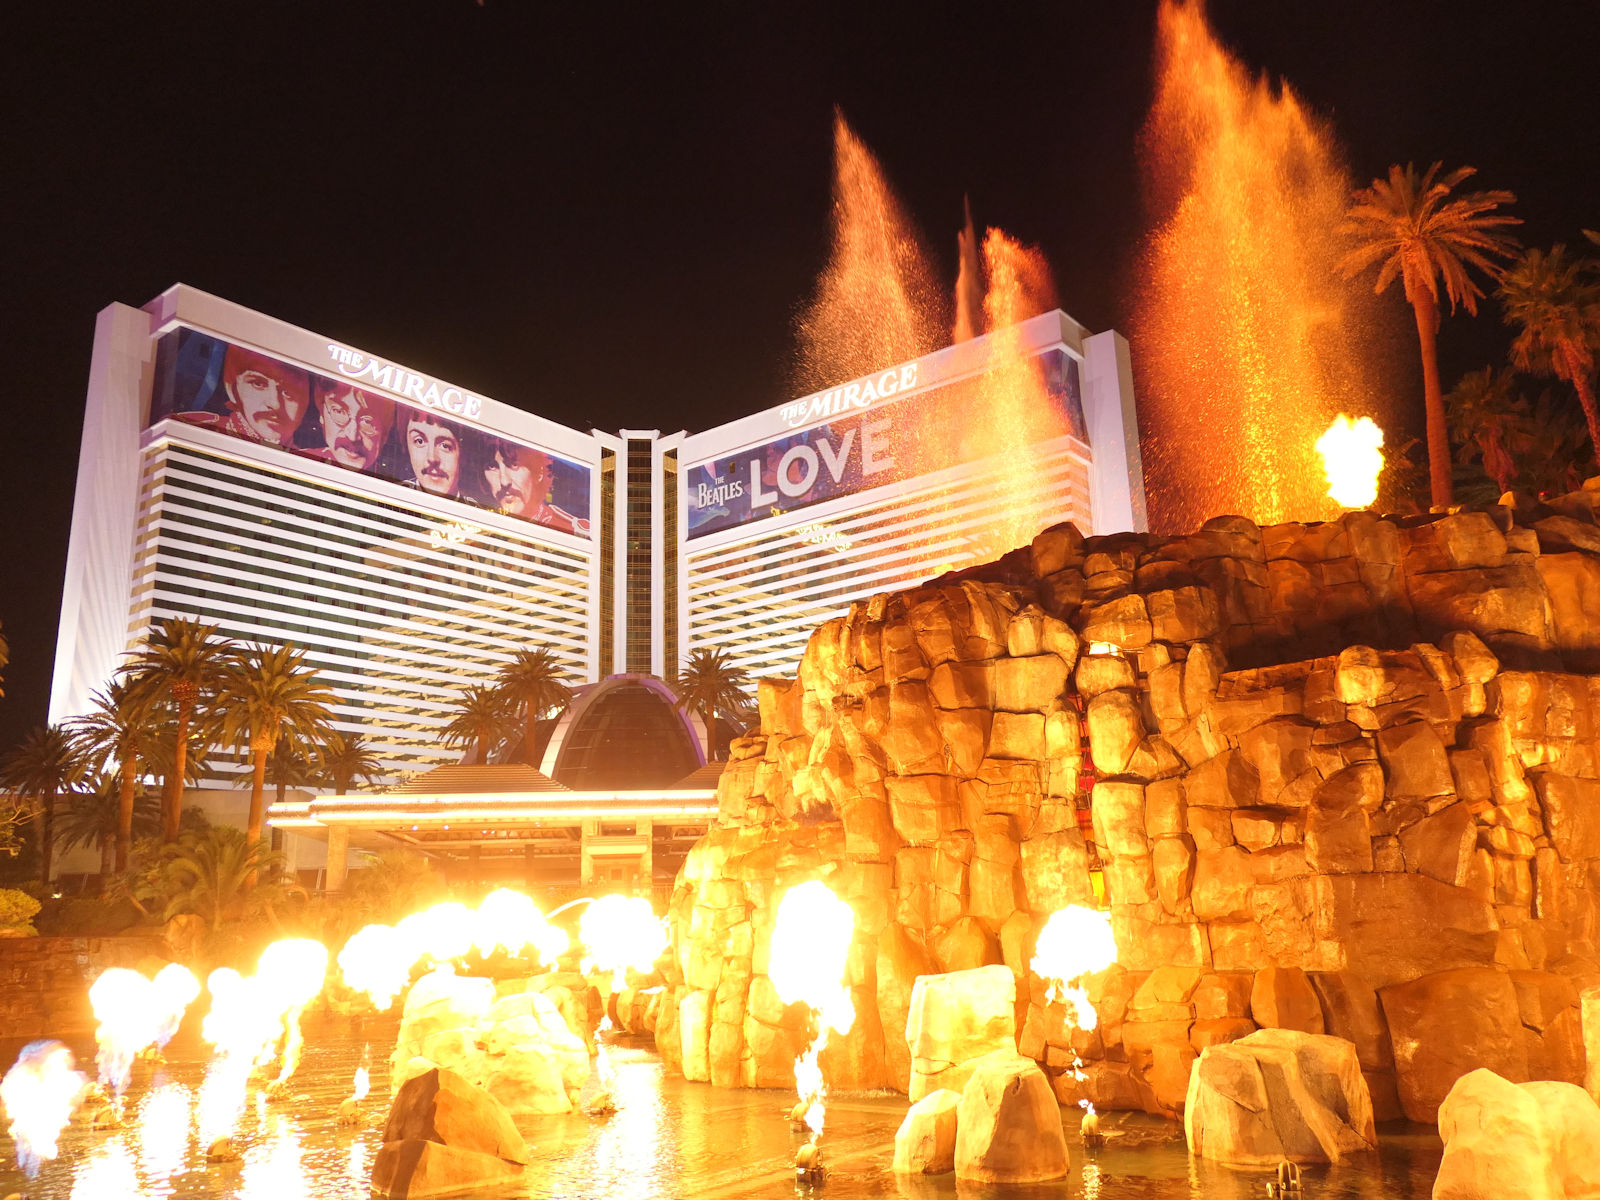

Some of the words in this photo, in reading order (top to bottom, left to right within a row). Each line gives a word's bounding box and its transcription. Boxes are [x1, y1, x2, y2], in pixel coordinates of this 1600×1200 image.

[328, 344, 364, 368] THE
[338, 358, 482, 420] MIRAGE
[789, 363, 918, 427] MIRAGE
[780, 401, 808, 420] THE
[750, 417, 895, 509] LOVE
[698, 480, 743, 509] BEATLES
[715, 475, 725, 485] THE
